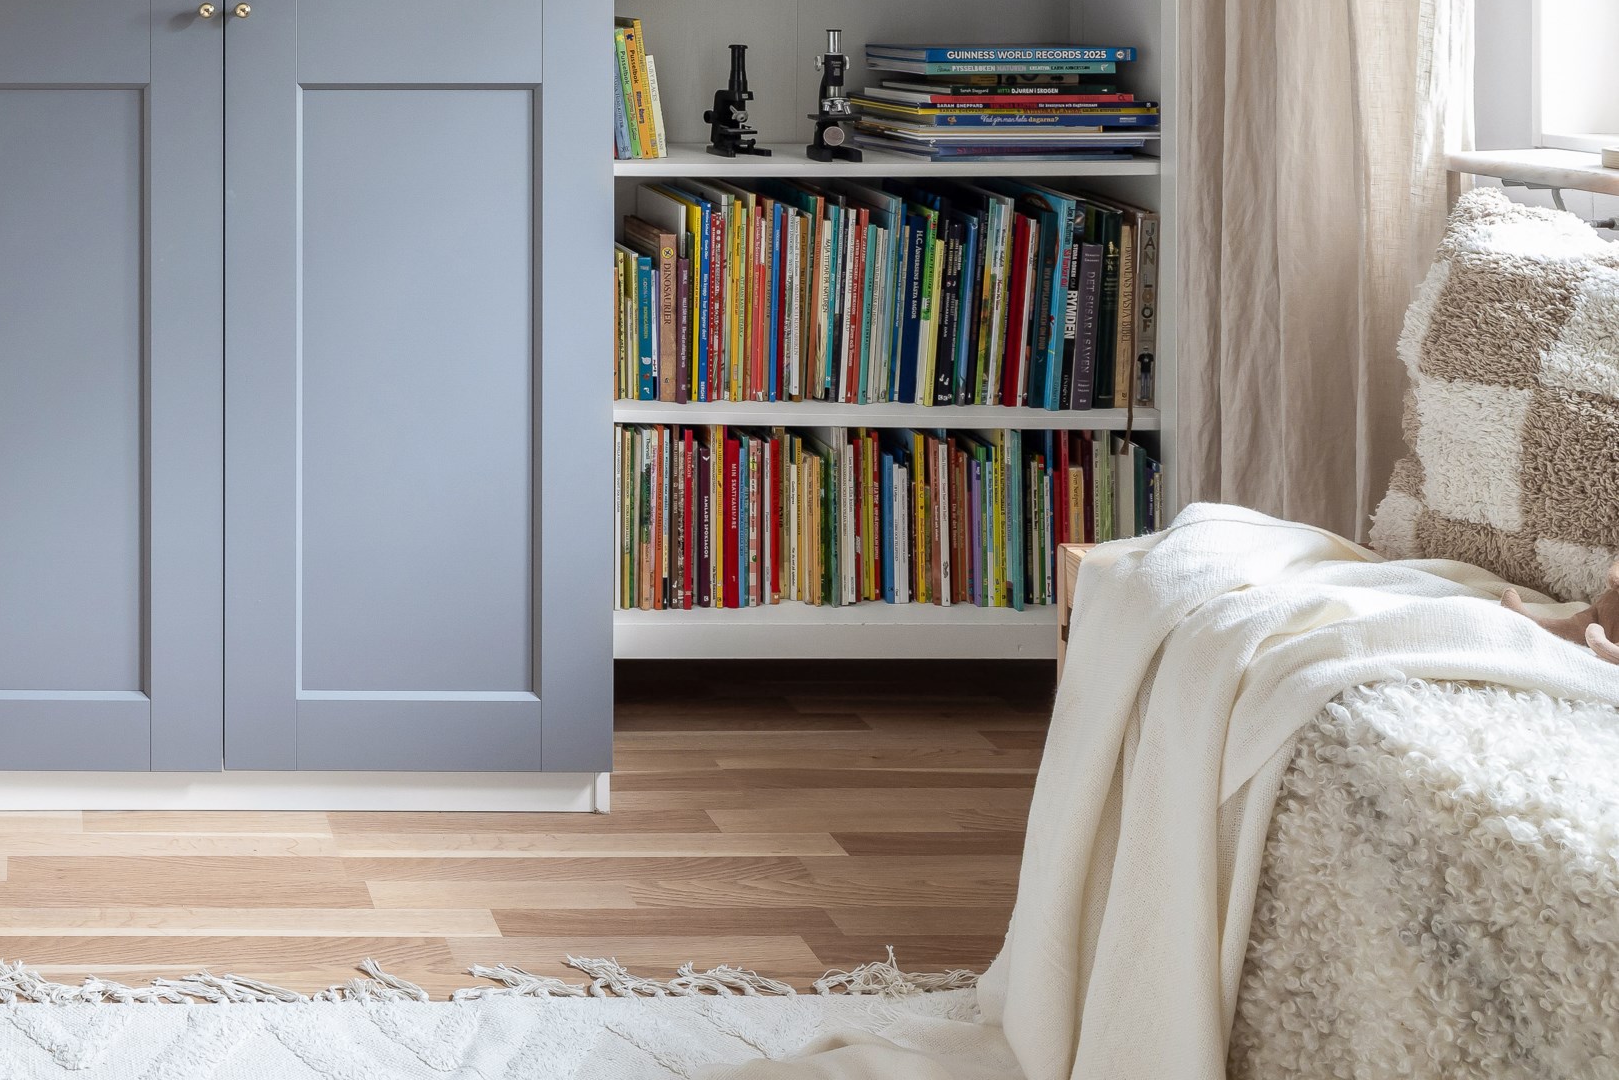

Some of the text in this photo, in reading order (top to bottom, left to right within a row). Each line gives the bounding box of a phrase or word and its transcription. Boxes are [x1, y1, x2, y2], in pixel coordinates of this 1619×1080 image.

[620, 51, 629, 86] Pusselbok
[630, 50, 639, 84] Pusselbok
[946, 50, 1107, 59] GUINNESS WORLD RECORDS 2025
[663, 263, 671, 325] DINOSAURIER
[1064, 291, 1078, 339] RYMDEN
